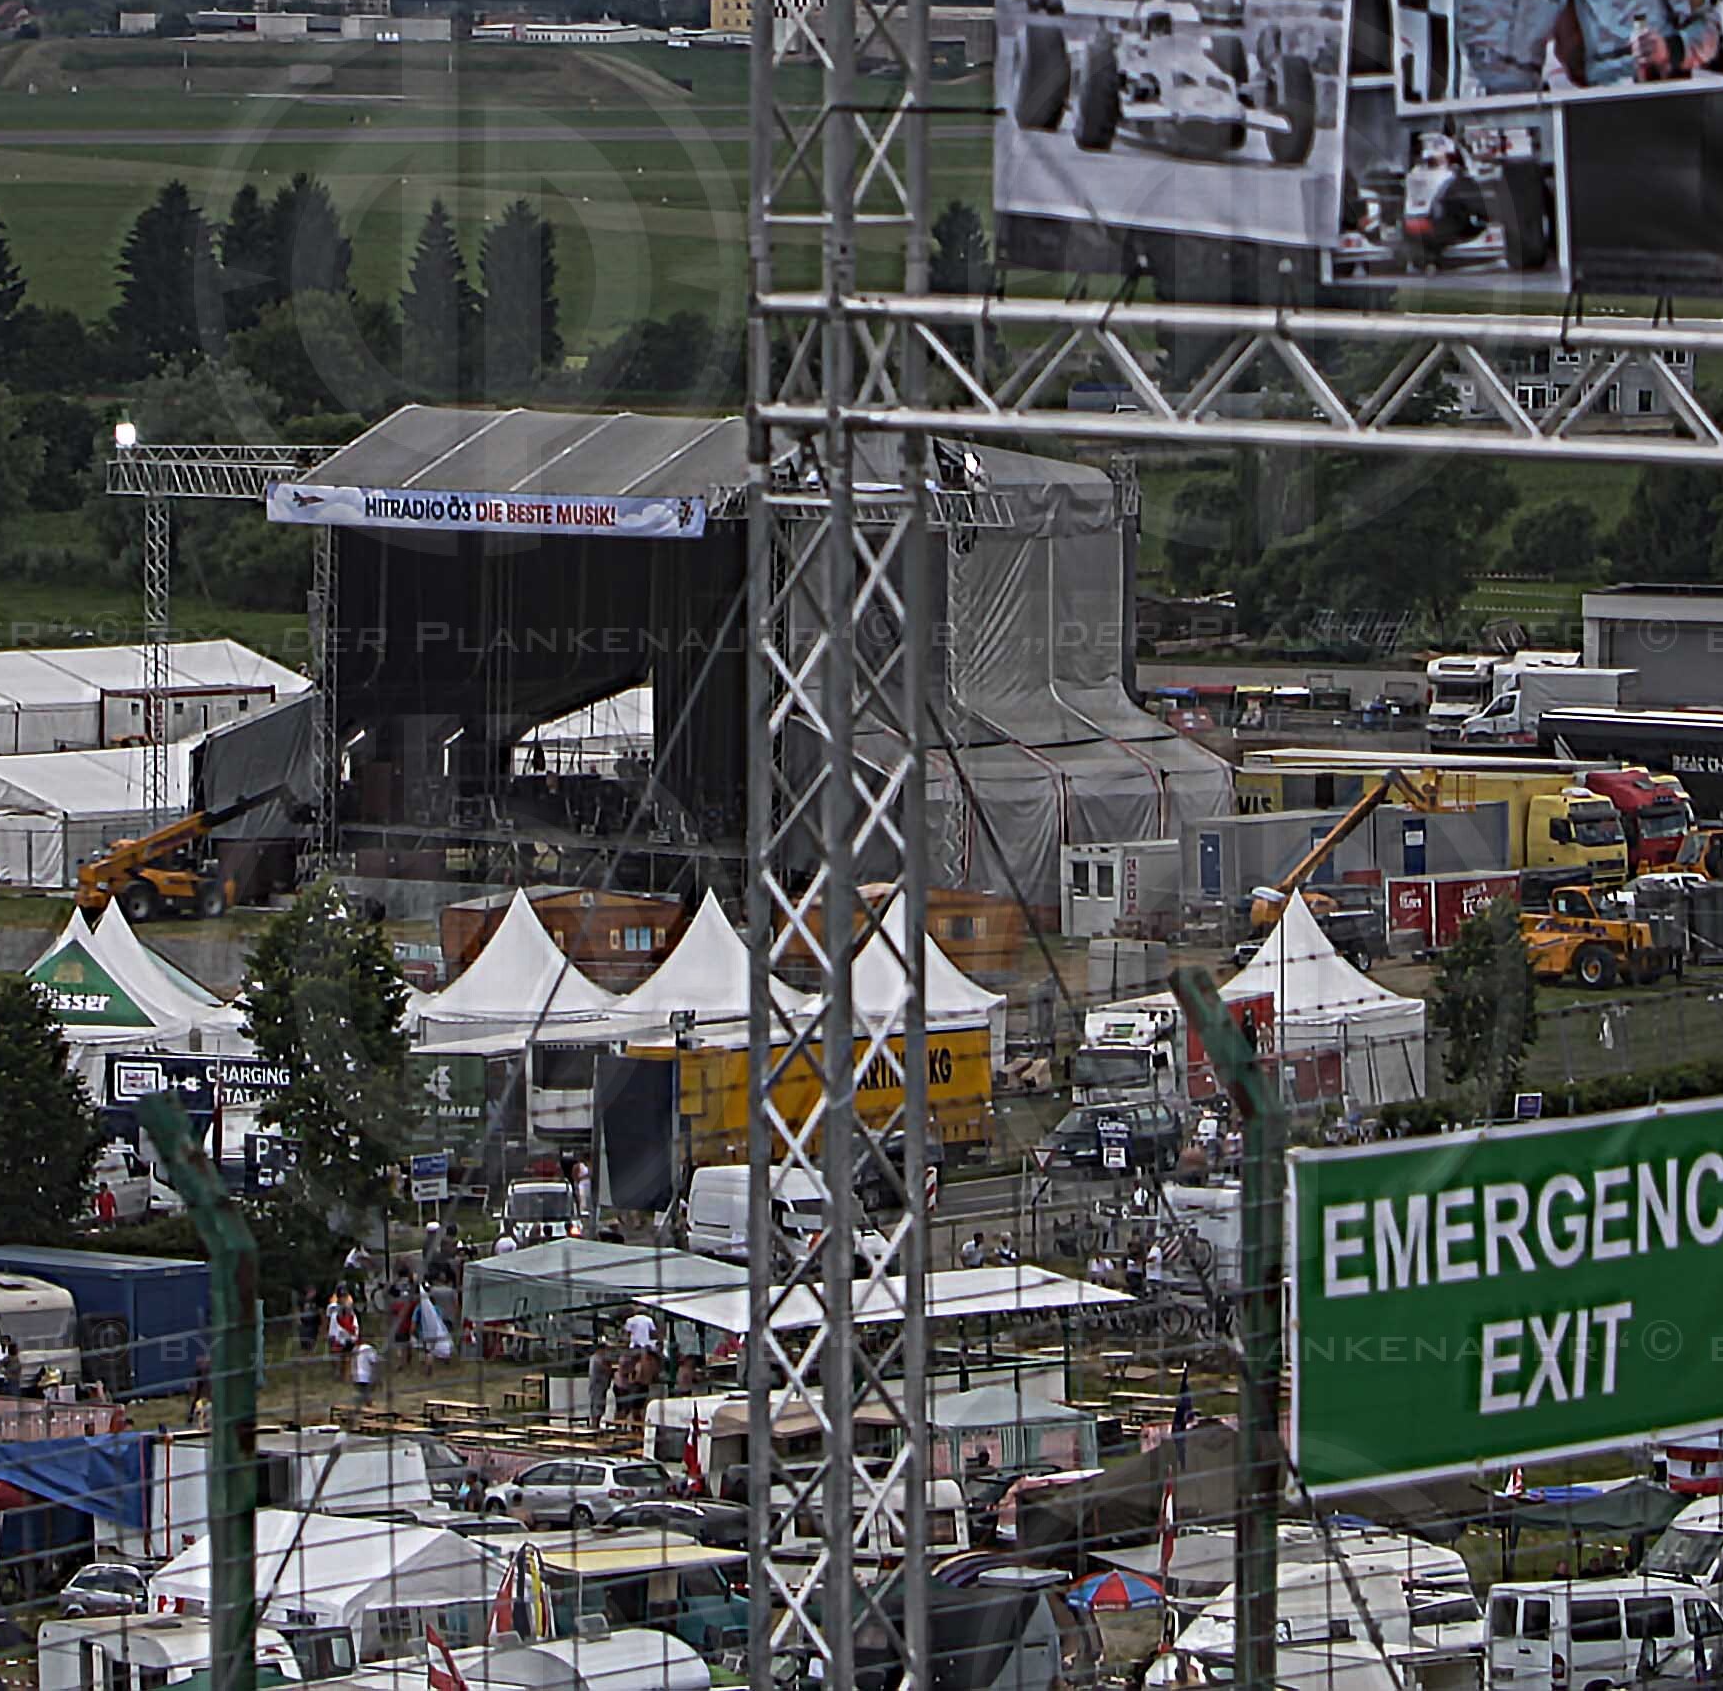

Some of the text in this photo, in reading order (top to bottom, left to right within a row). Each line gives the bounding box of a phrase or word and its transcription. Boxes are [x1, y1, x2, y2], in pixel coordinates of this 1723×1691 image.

[364, 495, 616, 526] HITRADIO Ö3 DIE BESTE MUSIK!
[206, 1065, 291, 1085] CHARGING
[929, 1047, 953, 1085] KG
[1477, 1300, 1633, 1415] EXIT
